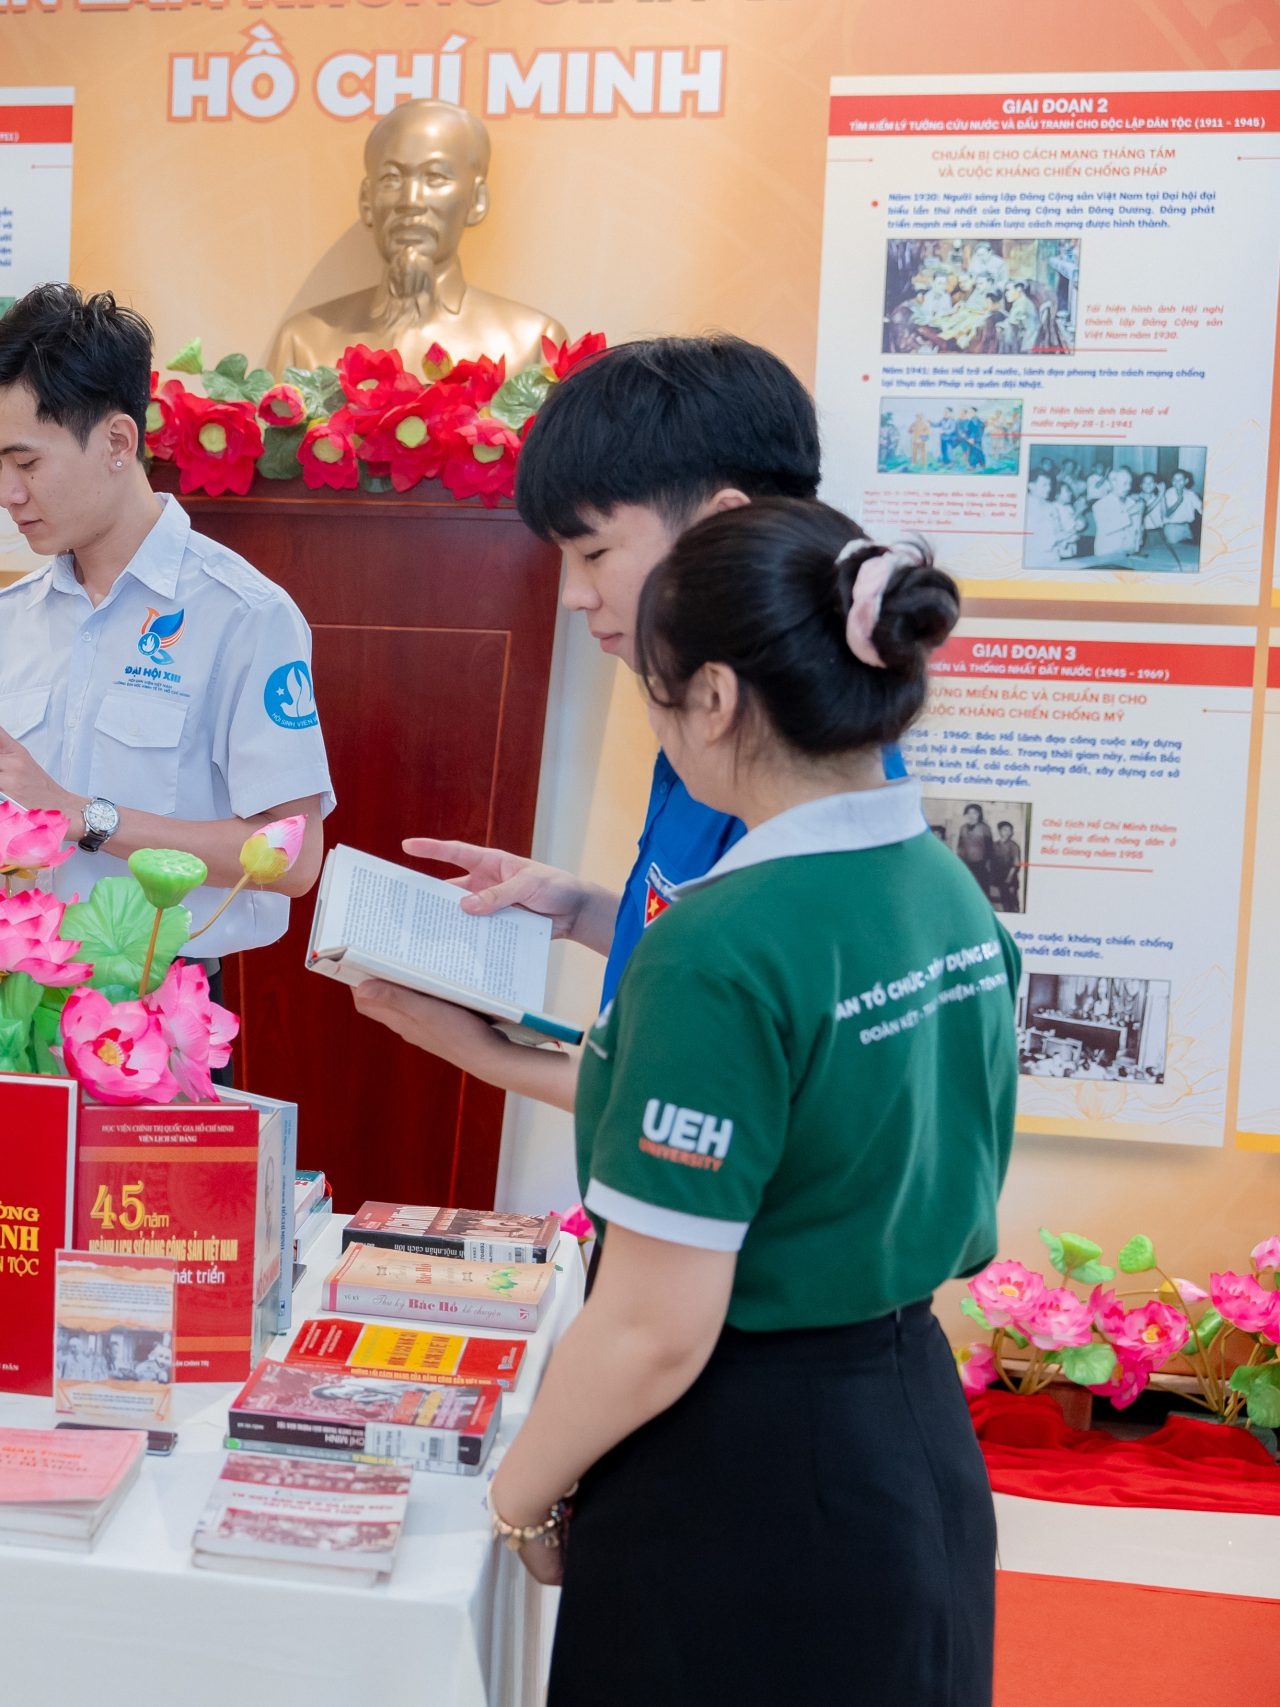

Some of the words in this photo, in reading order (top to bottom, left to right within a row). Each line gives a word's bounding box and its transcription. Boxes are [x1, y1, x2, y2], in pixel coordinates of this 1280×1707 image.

[171, 24, 295, 116] HỒ
[319, 34, 468, 116] CHÍ
[489, 49, 720, 114] MINH
[1002, 99, 1039, 114] GIAI
[1042, 98, 1093, 117] ĐOẠN
[1097, 98, 1108, 113] 2
[1001, 118, 1015, 130] VÀ
[1039, 116, 1076, 129] TRANH
[1075, 119, 1100, 129] CHO
[1099, 117, 1123, 131] ĐỘC
[1125, 117, 1146, 130] LẬP
[1145, 117, 1169, 128] DÂN
[1171, 116, 1192, 130] TỘC
[1194, 117, 1223, 129] (1911
[1234, 117, 1265, 128] 1945)
[932, 146, 976, 160] CHUẨN
[978, 151, 990, 162] BỊ
[993, 150, 1020, 160] CHO
[1023, 147, 1057, 160] CÁCH
[1060, 150, 1098, 163] MẠNG
[1103, 146, 1145, 163] THÁNG
[1150, 145, 1176, 159] TÁM
[939, 165, 954, 177] VÀ
[957, 165, 992, 179] CUỘC
[996, 164, 1040, 177] KHÁNG
[1043, 163, 1082, 177] CHIẾN
[1084, 162, 1130, 177] CHỐNG
[1133, 163, 1167, 176] PHÁP
[1119, 192, 1143, 201] Nam
[1162, 191, 1179, 201] Đại
[972, 643, 1008, 658] GIAI
[1011, 644, 1062, 663] ĐOẠN
[1065, 646, 1076, 661] 3
[124, 665, 141, 677] ĐẠI
[143, 667, 161, 680] HỘI
[163, 671, 181, 683] XIII
[951, 661, 966, 673] VÀ
[1001, 687, 1027, 700] BẮC
[1032, 688, 1048, 701] VÀ
[1052, 689, 1100, 703] CHUẨN
[1102, 693, 1115, 705] BỊ
[1118, 693, 1148, 705] CHO
[959, 704, 1005, 718] KHÁNG
[1009, 706, 1049, 720] CHIẾN
[1052, 707, 1100, 721] CHỐNG
[1104, 709, 1124, 722] MỸ
[835, 998, 861, 1021] AN
[860, 980, 887, 1010] TỔ
[887, 970, 926, 1000] CHỨC
[641, 1098, 733, 1159] UEH
[90, 1180, 145, 1231] 45
[143, 1211, 170, 1228] năm
[187, 1230, 203, 1262] SẢN
[204, 1235, 219, 1265] VIỆT
[220, 1239, 238, 1262] NAM
[8, 1254, 39, 1276] TỘC
[175, 1269, 193, 1284] hát
[196, 1262, 225, 1284] triển
[408, 1298, 436, 1312] Bác
[439, 1299, 458, 1313] Hồ
